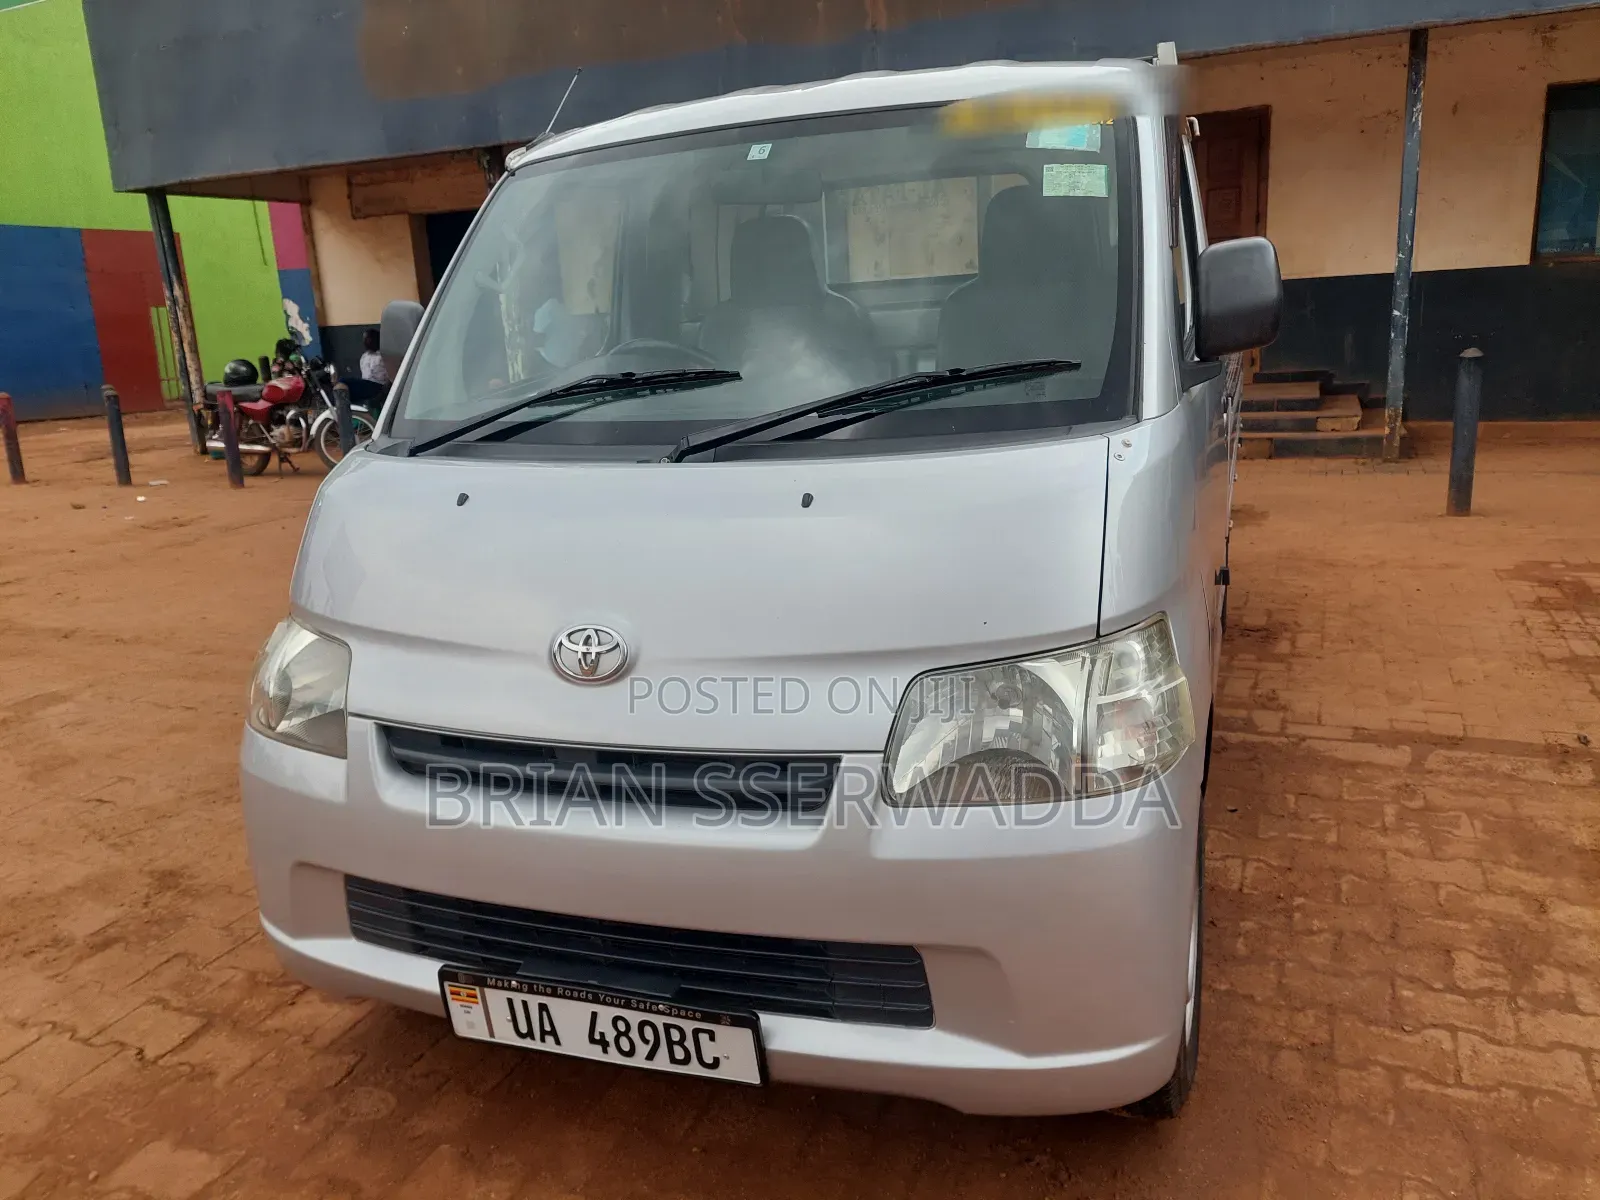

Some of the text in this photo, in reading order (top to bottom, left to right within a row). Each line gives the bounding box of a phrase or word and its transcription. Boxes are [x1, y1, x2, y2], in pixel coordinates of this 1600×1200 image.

[758, 145, 767, 155] 6
[533, 984, 552, 994] the
[557, 987, 593, 1000] Roads
[599, 993, 626, 1006] Your
[630, 999, 659, 1012] Safe
[663, 1004, 702, 1020] Space
[506, 997, 720, 1071] UA 489BC
